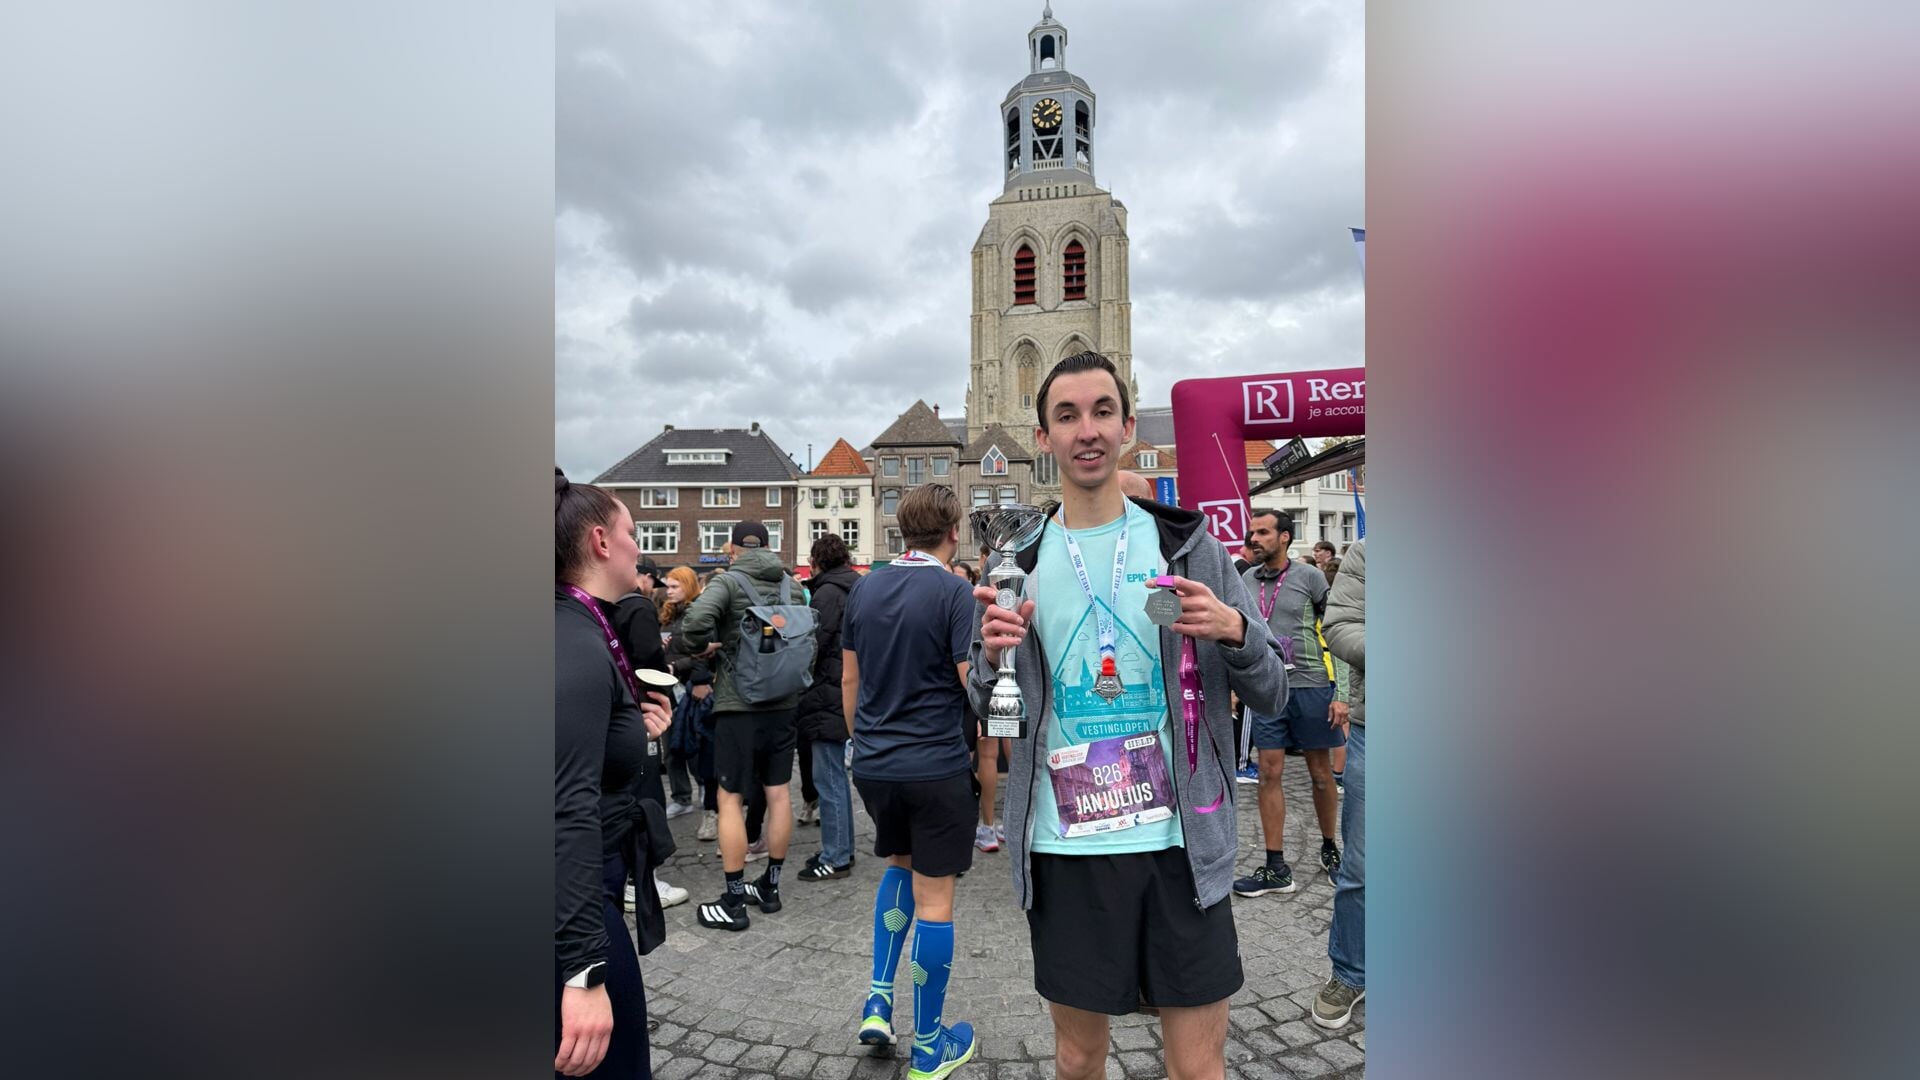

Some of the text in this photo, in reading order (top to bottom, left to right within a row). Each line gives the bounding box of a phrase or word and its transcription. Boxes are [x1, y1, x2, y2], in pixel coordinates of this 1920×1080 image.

[1308, 405, 1321, 420] je
[1126, 573, 1148, 583] EPIC
[1082, 721, 1150, 736] VESTINGLOPEN
[1092, 763, 1123, 786] 826
[1075, 782, 1154, 815] JANJULIUS
